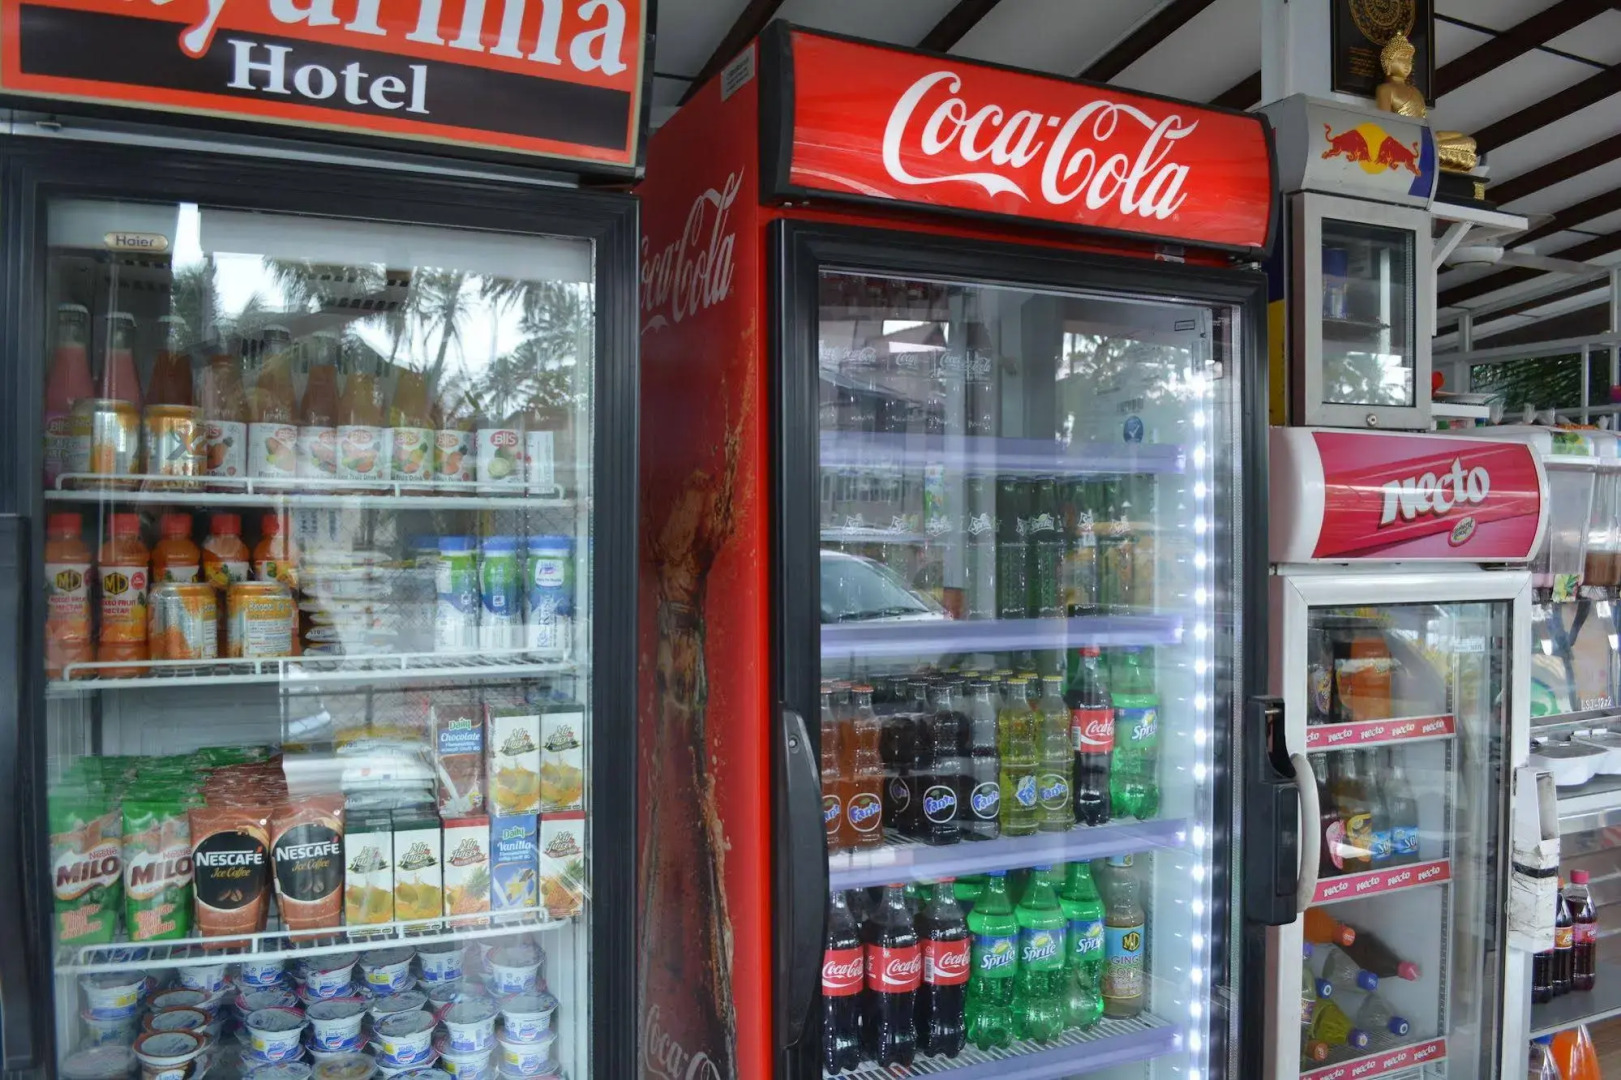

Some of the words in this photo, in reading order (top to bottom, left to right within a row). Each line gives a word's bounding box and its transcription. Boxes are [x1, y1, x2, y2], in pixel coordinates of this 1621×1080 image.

[227, 39, 430, 114] Hotel
[882, 71, 1199, 221] Coca-Cola
[115, 235, 154, 247] Haier
[1380, 456, 1491, 525] Necto
[105, 575, 128, 593] MD
[440, 732, 481, 742] Chocolate
[1328, 728, 1353, 743] Necto
[1360, 726, 1385, 740] Necto
[1391, 723, 1415, 737] Necto
[1039, 782, 1068, 800] Fanta
[850, 802, 881, 823] Fanta
[924, 794, 956, 815] Fanta
[496, 840, 532, 852] Vanilla
[56, 855, 121, 887] MILO
[130, 856, 193, 887] MILO
[226, 866, 251, 879] Coffee
[306, 858, 331, 871] Coffee
[1387, 871, 1411, 886] Necto
[1418, 866, 1440, 881] Necto
[1323, 881, 1348, 897] Necto
[1355, 876, 1380, 891] Necto
[981, 949, 1016, 970] Sprite
[1022, 944, 1056, 962] Sprite
